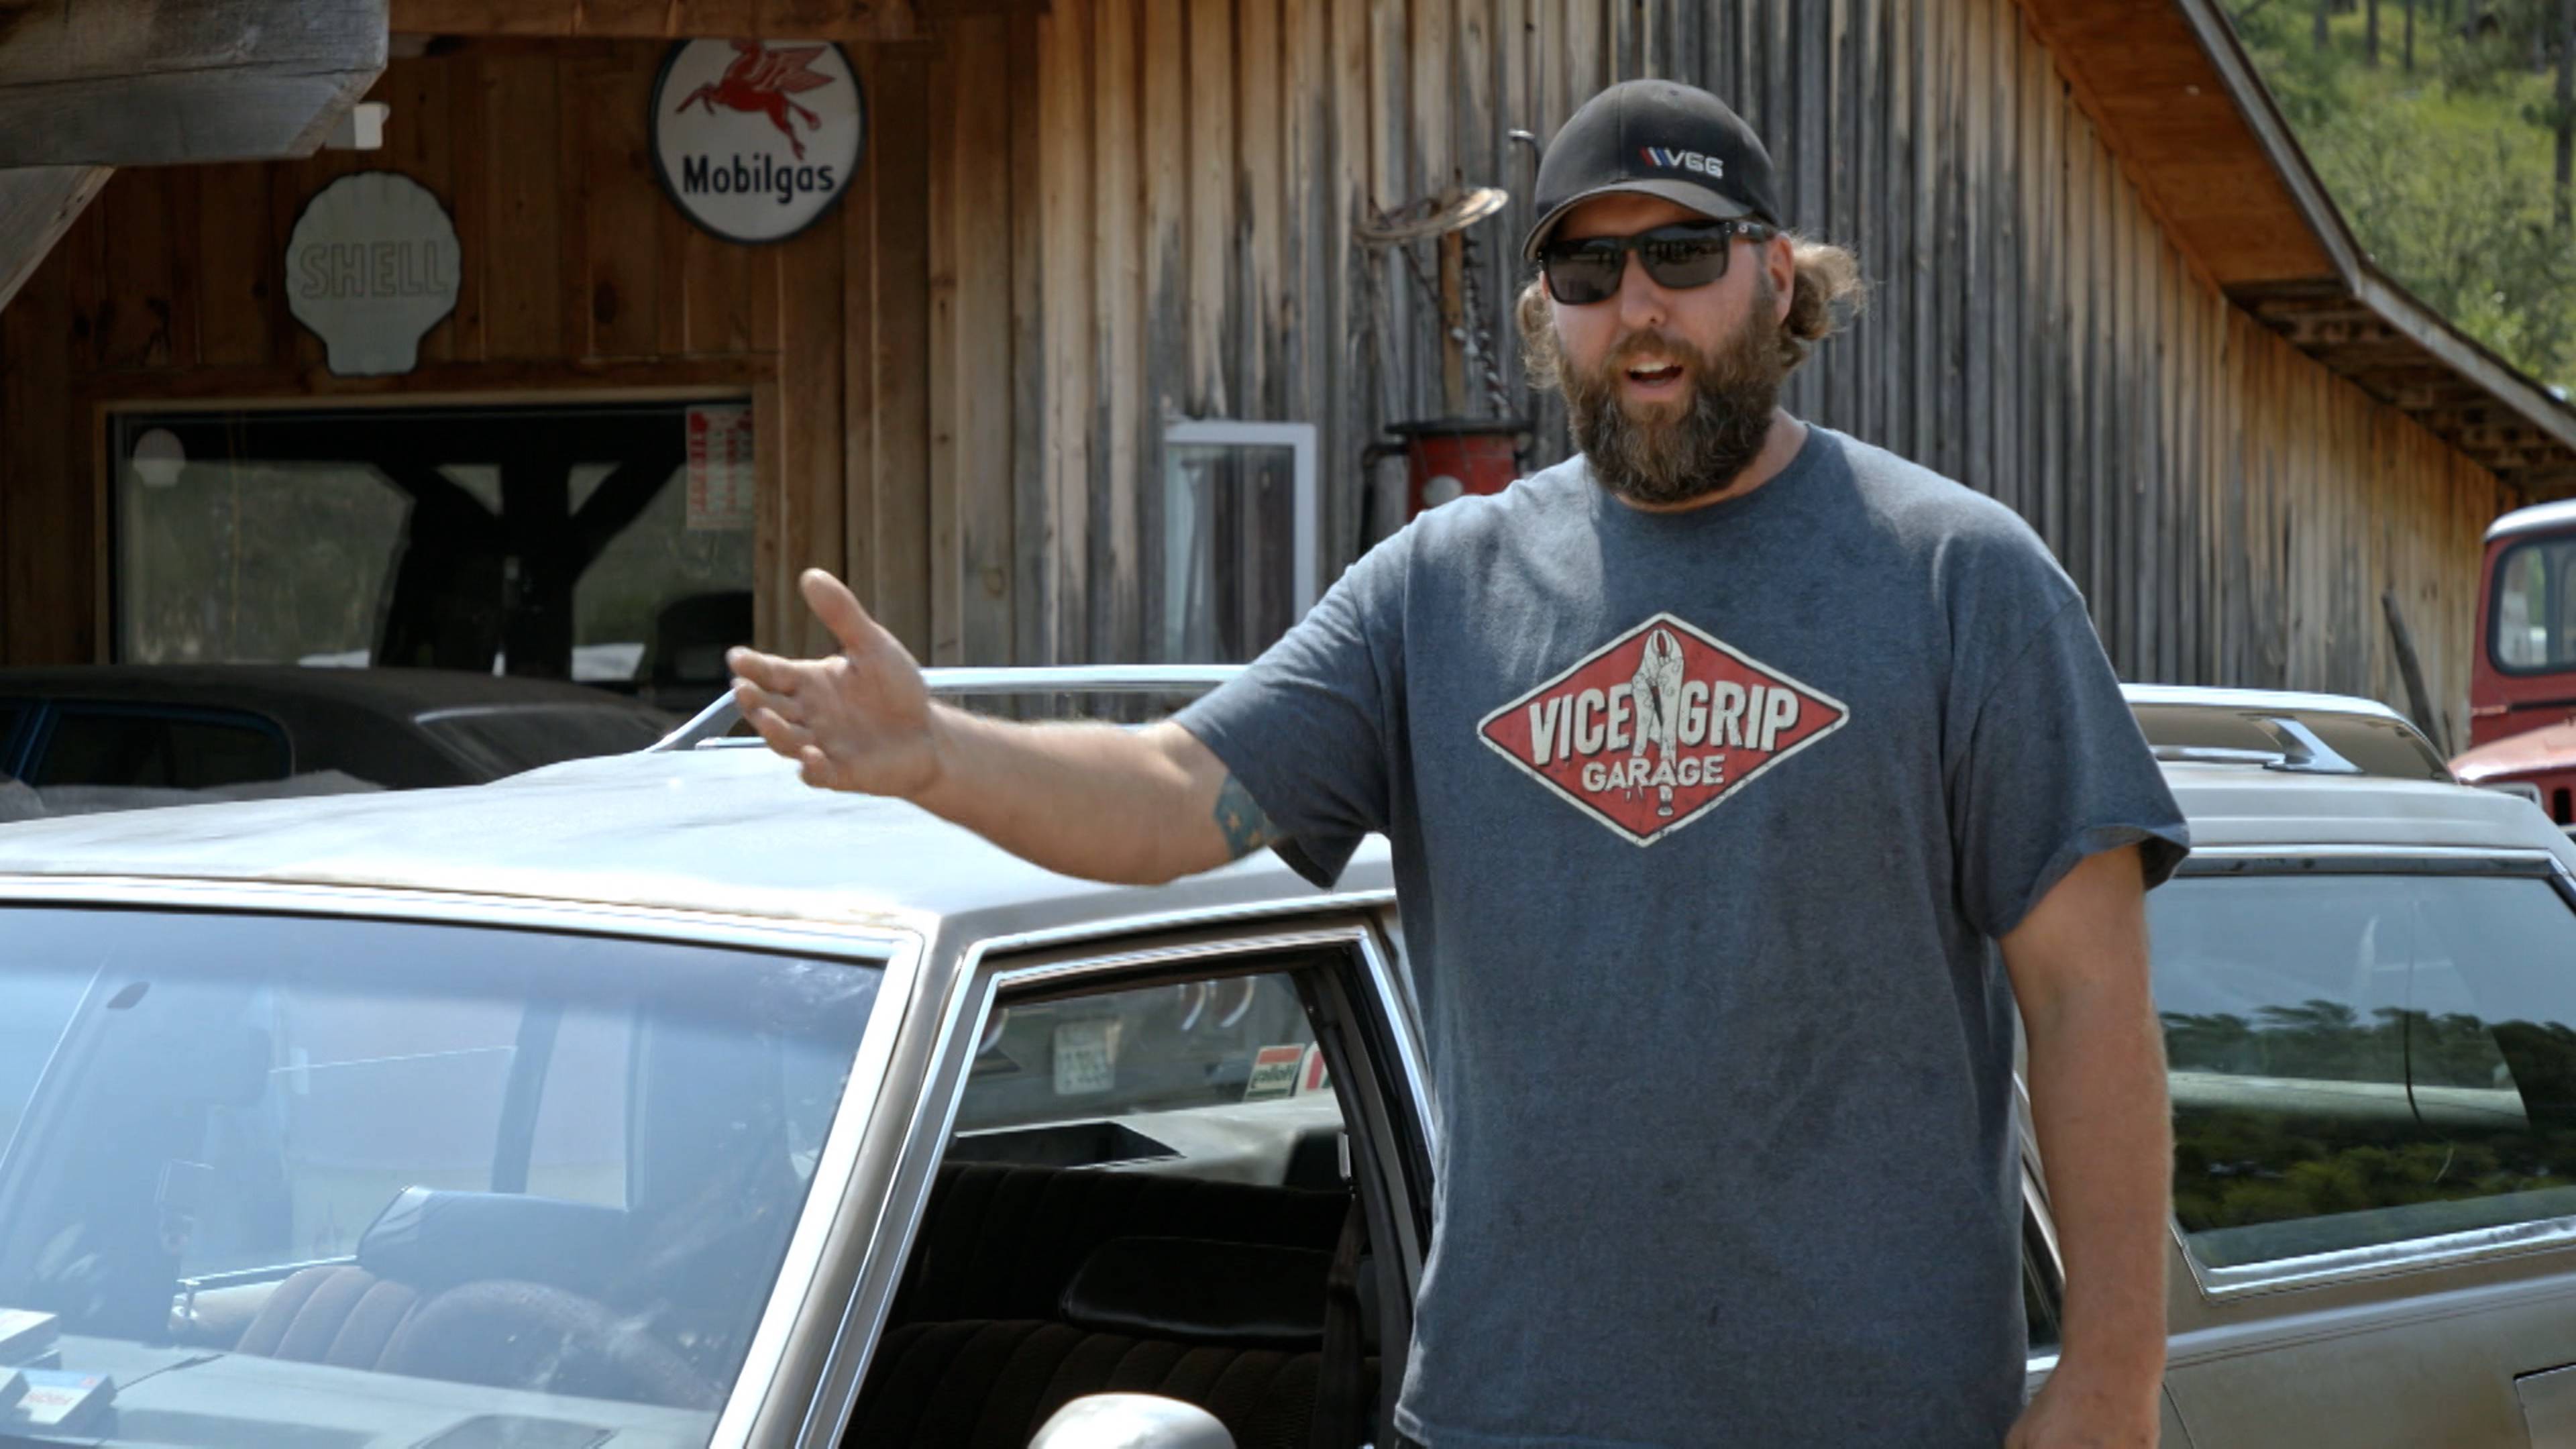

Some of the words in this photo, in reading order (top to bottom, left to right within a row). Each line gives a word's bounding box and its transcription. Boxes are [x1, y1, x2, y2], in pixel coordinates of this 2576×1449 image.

[682, 153, 834, 204] Mobilgas
[301, 241, 449, 300] SHELL
[1529, 683, 1633, 765] VICE
[1678, 680, 1800, 752] GRIP
[1581, 753, 1726, 793] GARAGE
